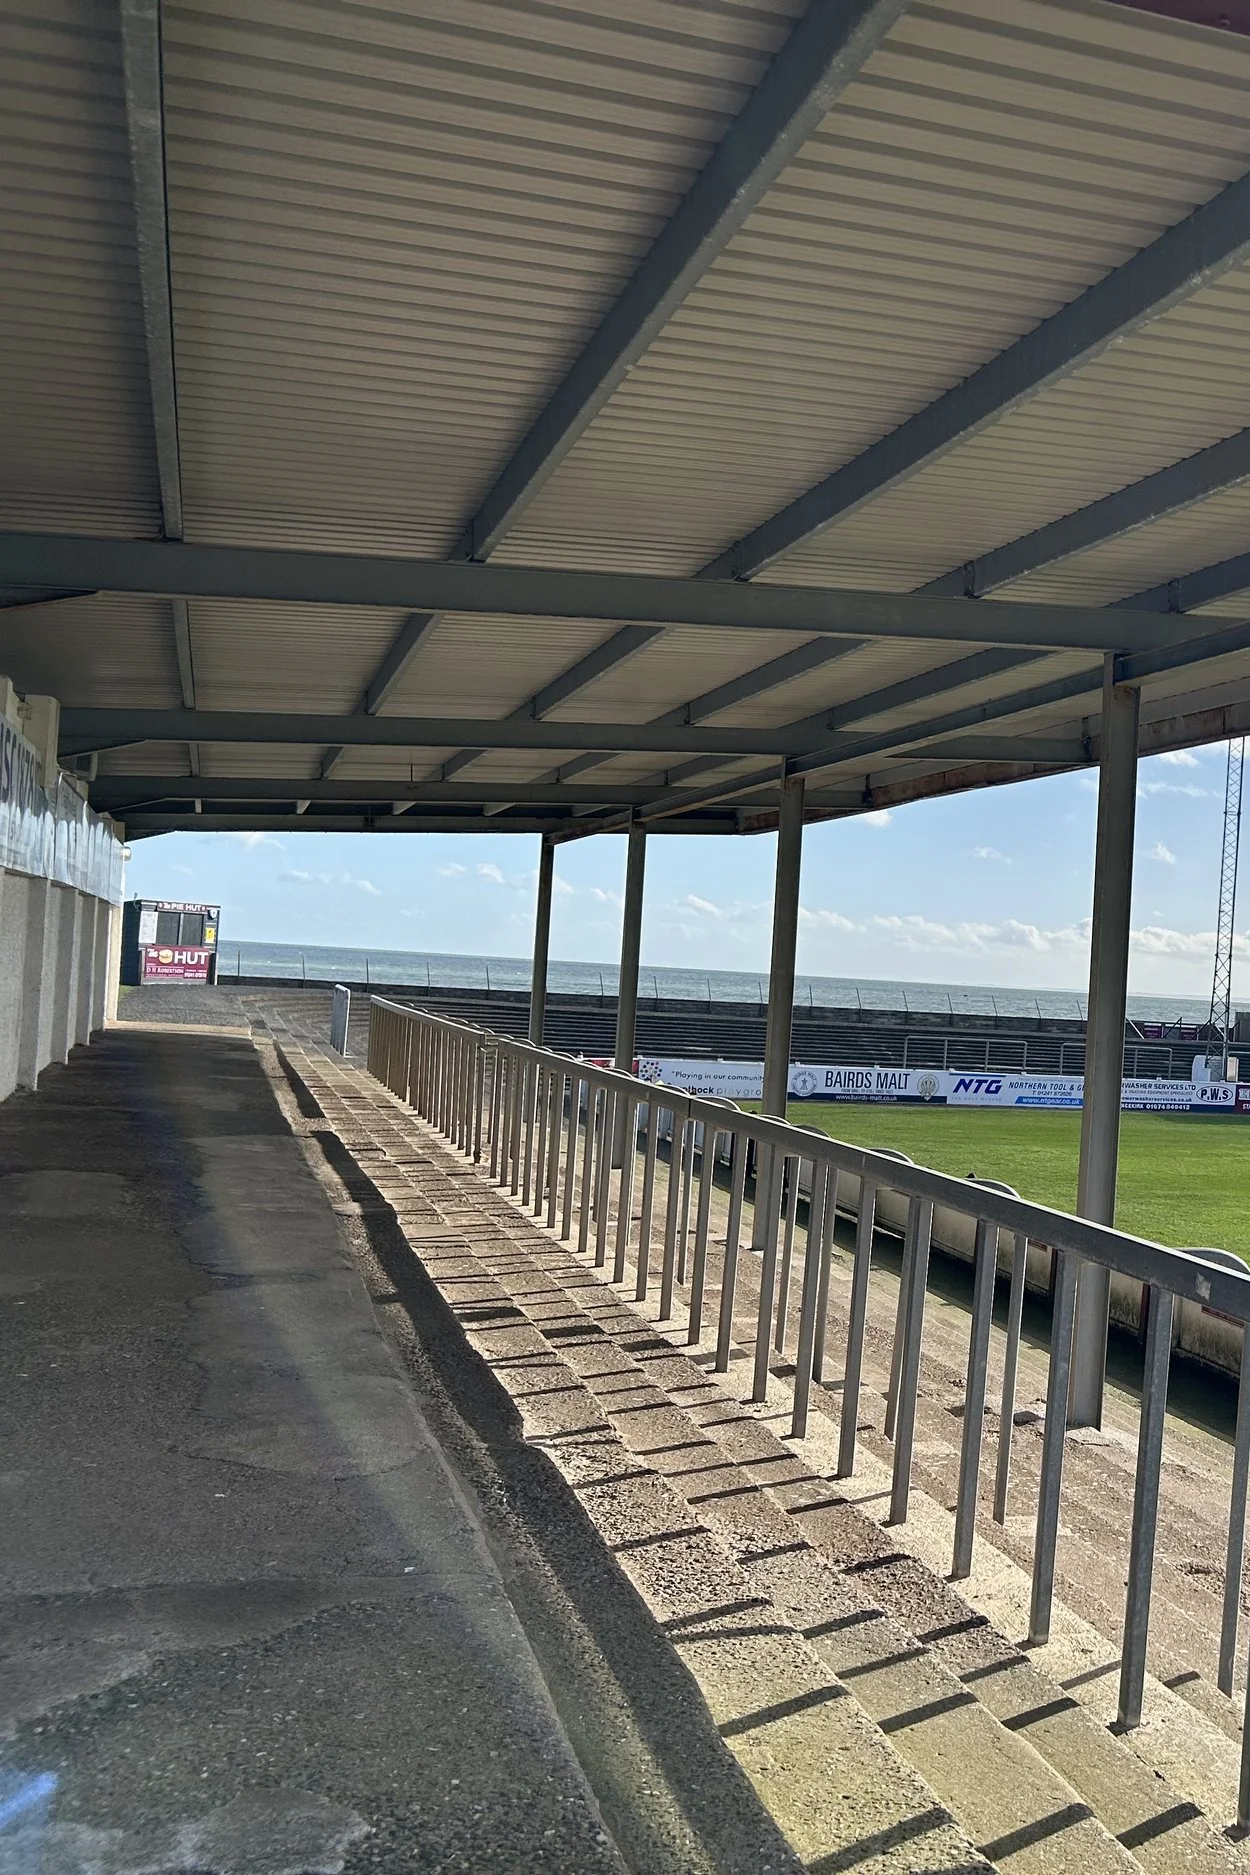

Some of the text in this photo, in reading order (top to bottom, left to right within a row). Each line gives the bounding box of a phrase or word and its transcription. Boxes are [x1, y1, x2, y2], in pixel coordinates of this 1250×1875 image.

[174, 951, 208, 965] HUT
[825, 1070, 910, 1089] BAIRDS MALT
[953, 1078, 1003, 1094] NTG
[1009, 1081, 1048, 1090] NORTHERN
[1154, 1083, 1184, 1091] SERVICES
[1200, 1088, 1229, 1101] P.W.S
